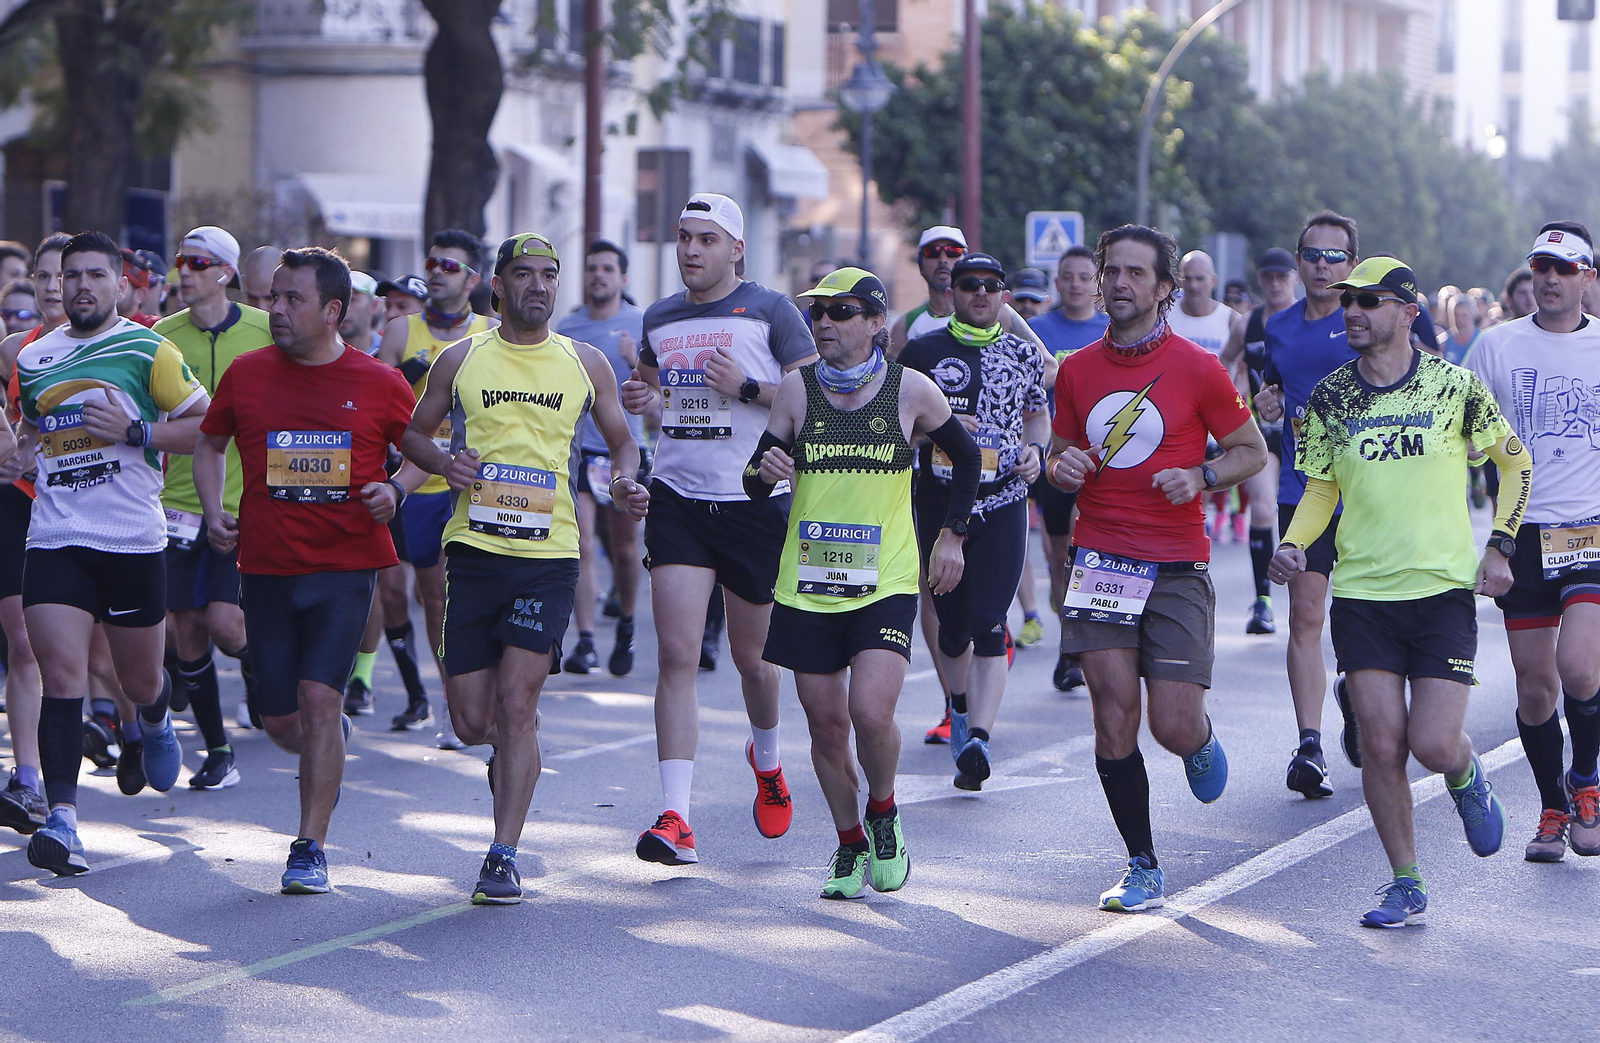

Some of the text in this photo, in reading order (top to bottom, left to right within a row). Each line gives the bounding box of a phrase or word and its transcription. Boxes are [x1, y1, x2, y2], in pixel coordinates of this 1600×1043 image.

[681, 374, 706, 383] ZUR
[481, 389, 564, 412] DEPORTEMANIA
[681, 398, 709, 409] 9218
[679, 415, 711, 424] GONCHO
[1345, 410, 1434, 437] DEPORTEMANIA
[62, 437, 92, 452] 5039
[295, 434, 342, 445] ZURICH
[1359, 432, 1424, 461] CXM
[804, 442, 896, 463] DEPORTEMANIA
[57, 452, 104, 468] MARCHENA
[288, 457, 331, 473] 4030
[500, 468, 547, 485] ZURICH
[496, 494, 529, 509] 4330
[1504, 469, 1531, 533] DEPORTEMANIA
[496, 512, 522, 524] NONO
[824, 528, 871, 540] ZURICH
[1567, 535, 1594, 549] 5771
[822, 551, 853, 564] 1218
[1547, 554, 1575, 565] CLARA
[1102, 559, 1149, 576] ZURICH
[825, 571, 848, 581] JUAN
[1095, 581, 1125, 595] 6331
[1090, 597, 1119, 609] PABLO
